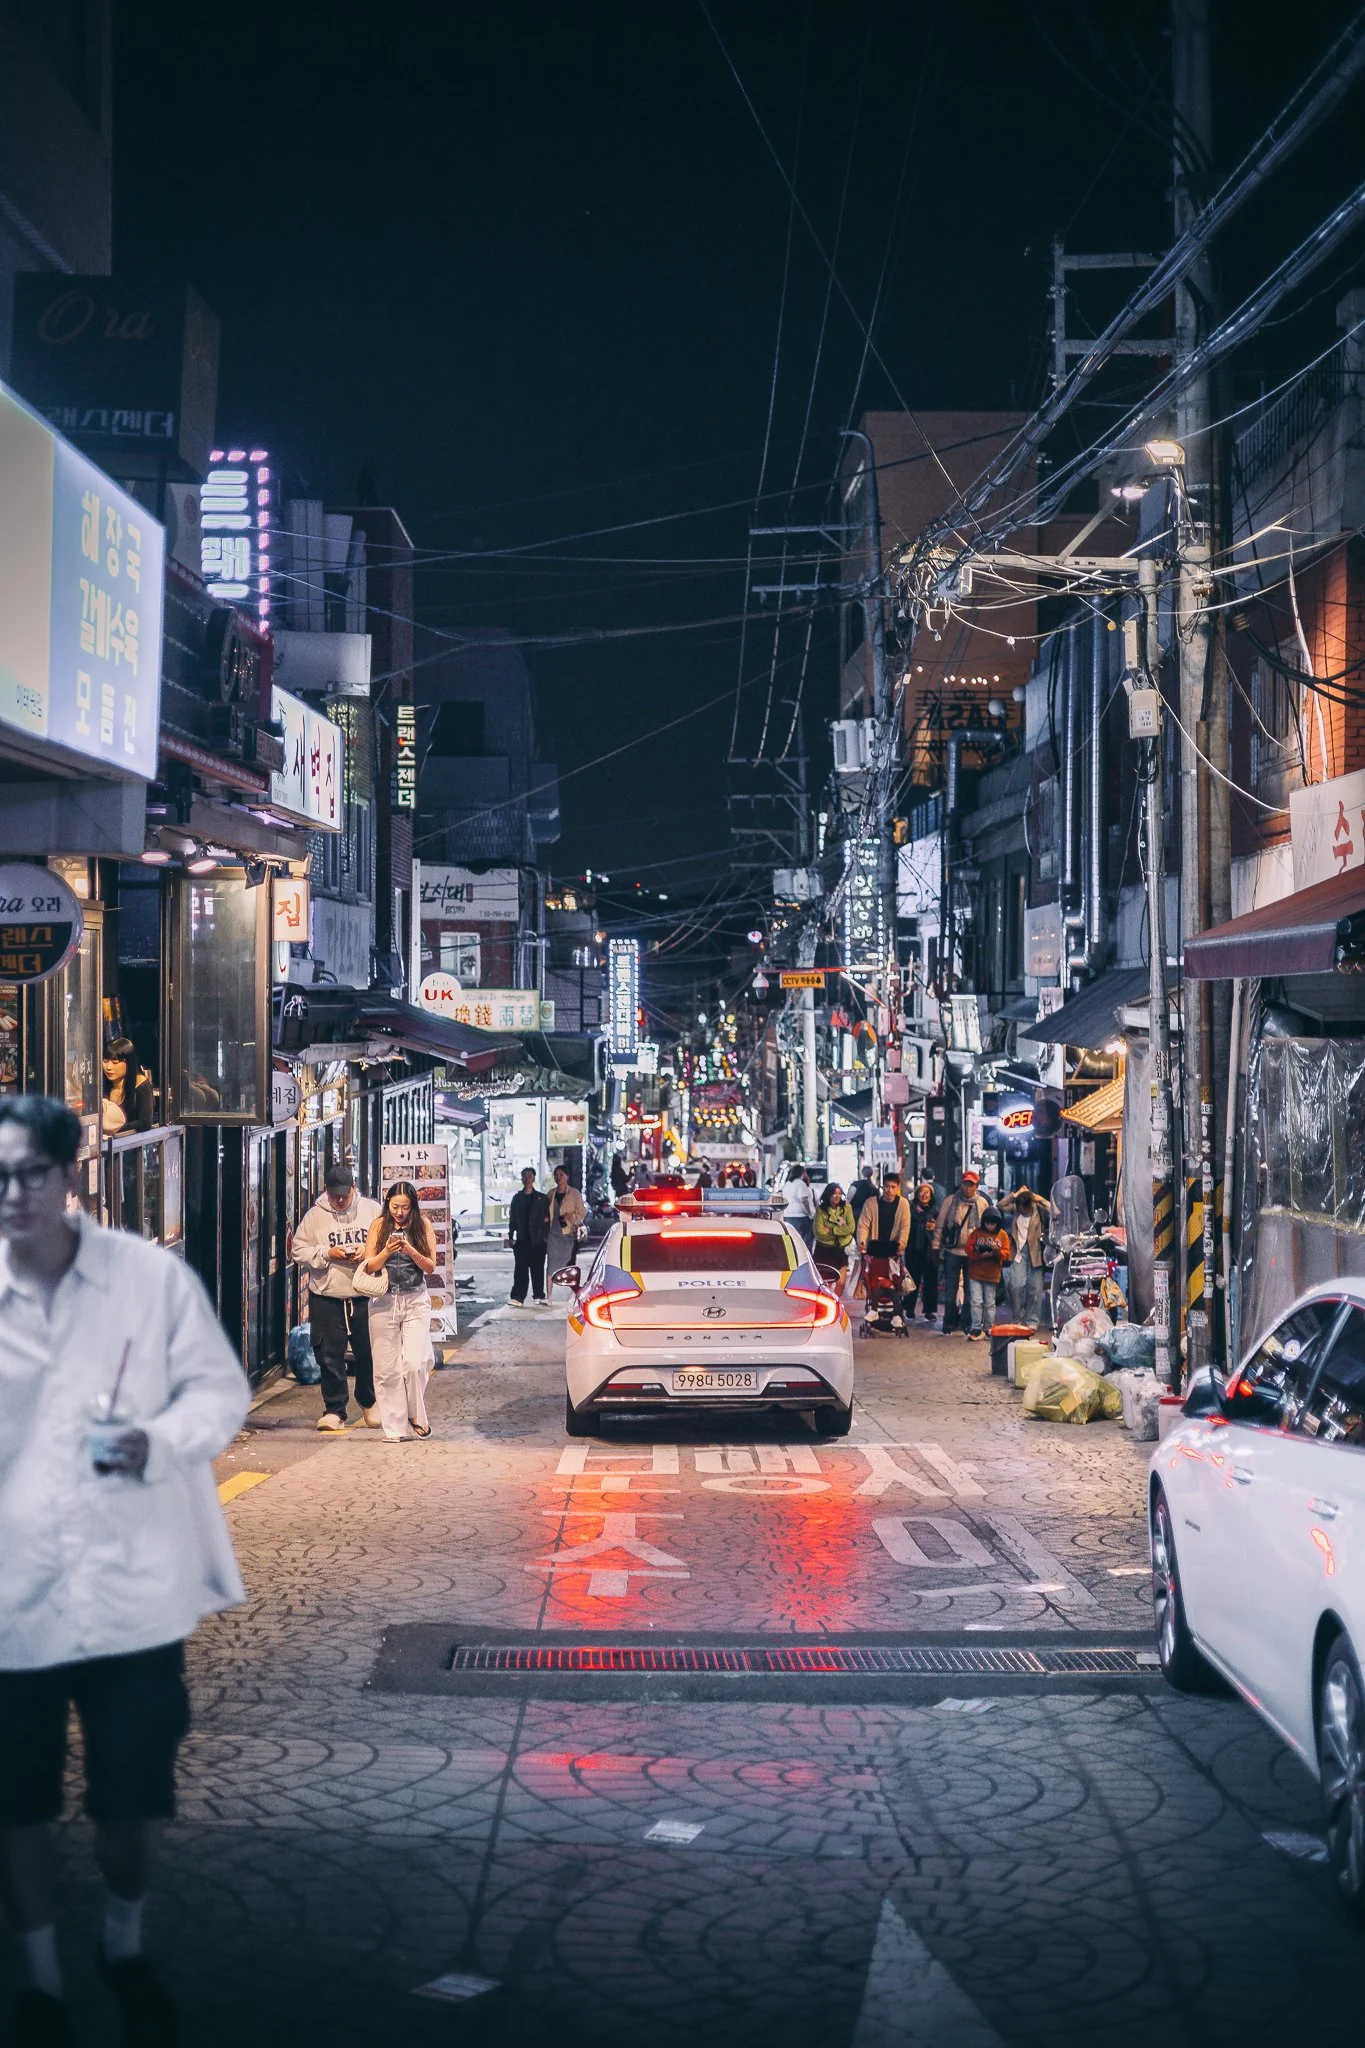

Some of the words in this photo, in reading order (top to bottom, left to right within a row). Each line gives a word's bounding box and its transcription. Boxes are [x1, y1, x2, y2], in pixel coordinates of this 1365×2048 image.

[37, 286, 154, 345] Ora
[81, 490, 141, 593] 해장국
[293, 714, 335, 818] 새벽집
[397, 705, 416, 809] 트랜스젠더
[1333, 800, 1365, 875] 수
[31, 896, 61, 913] 오라
[277, 890, 300, 927] 집
[425, 988, 453, 1000] UK
[782, 976, 799, 985] CCTV
[717, 1373, 752, 1387] 5028
[552, 1443, 988, 1498] 보행자
